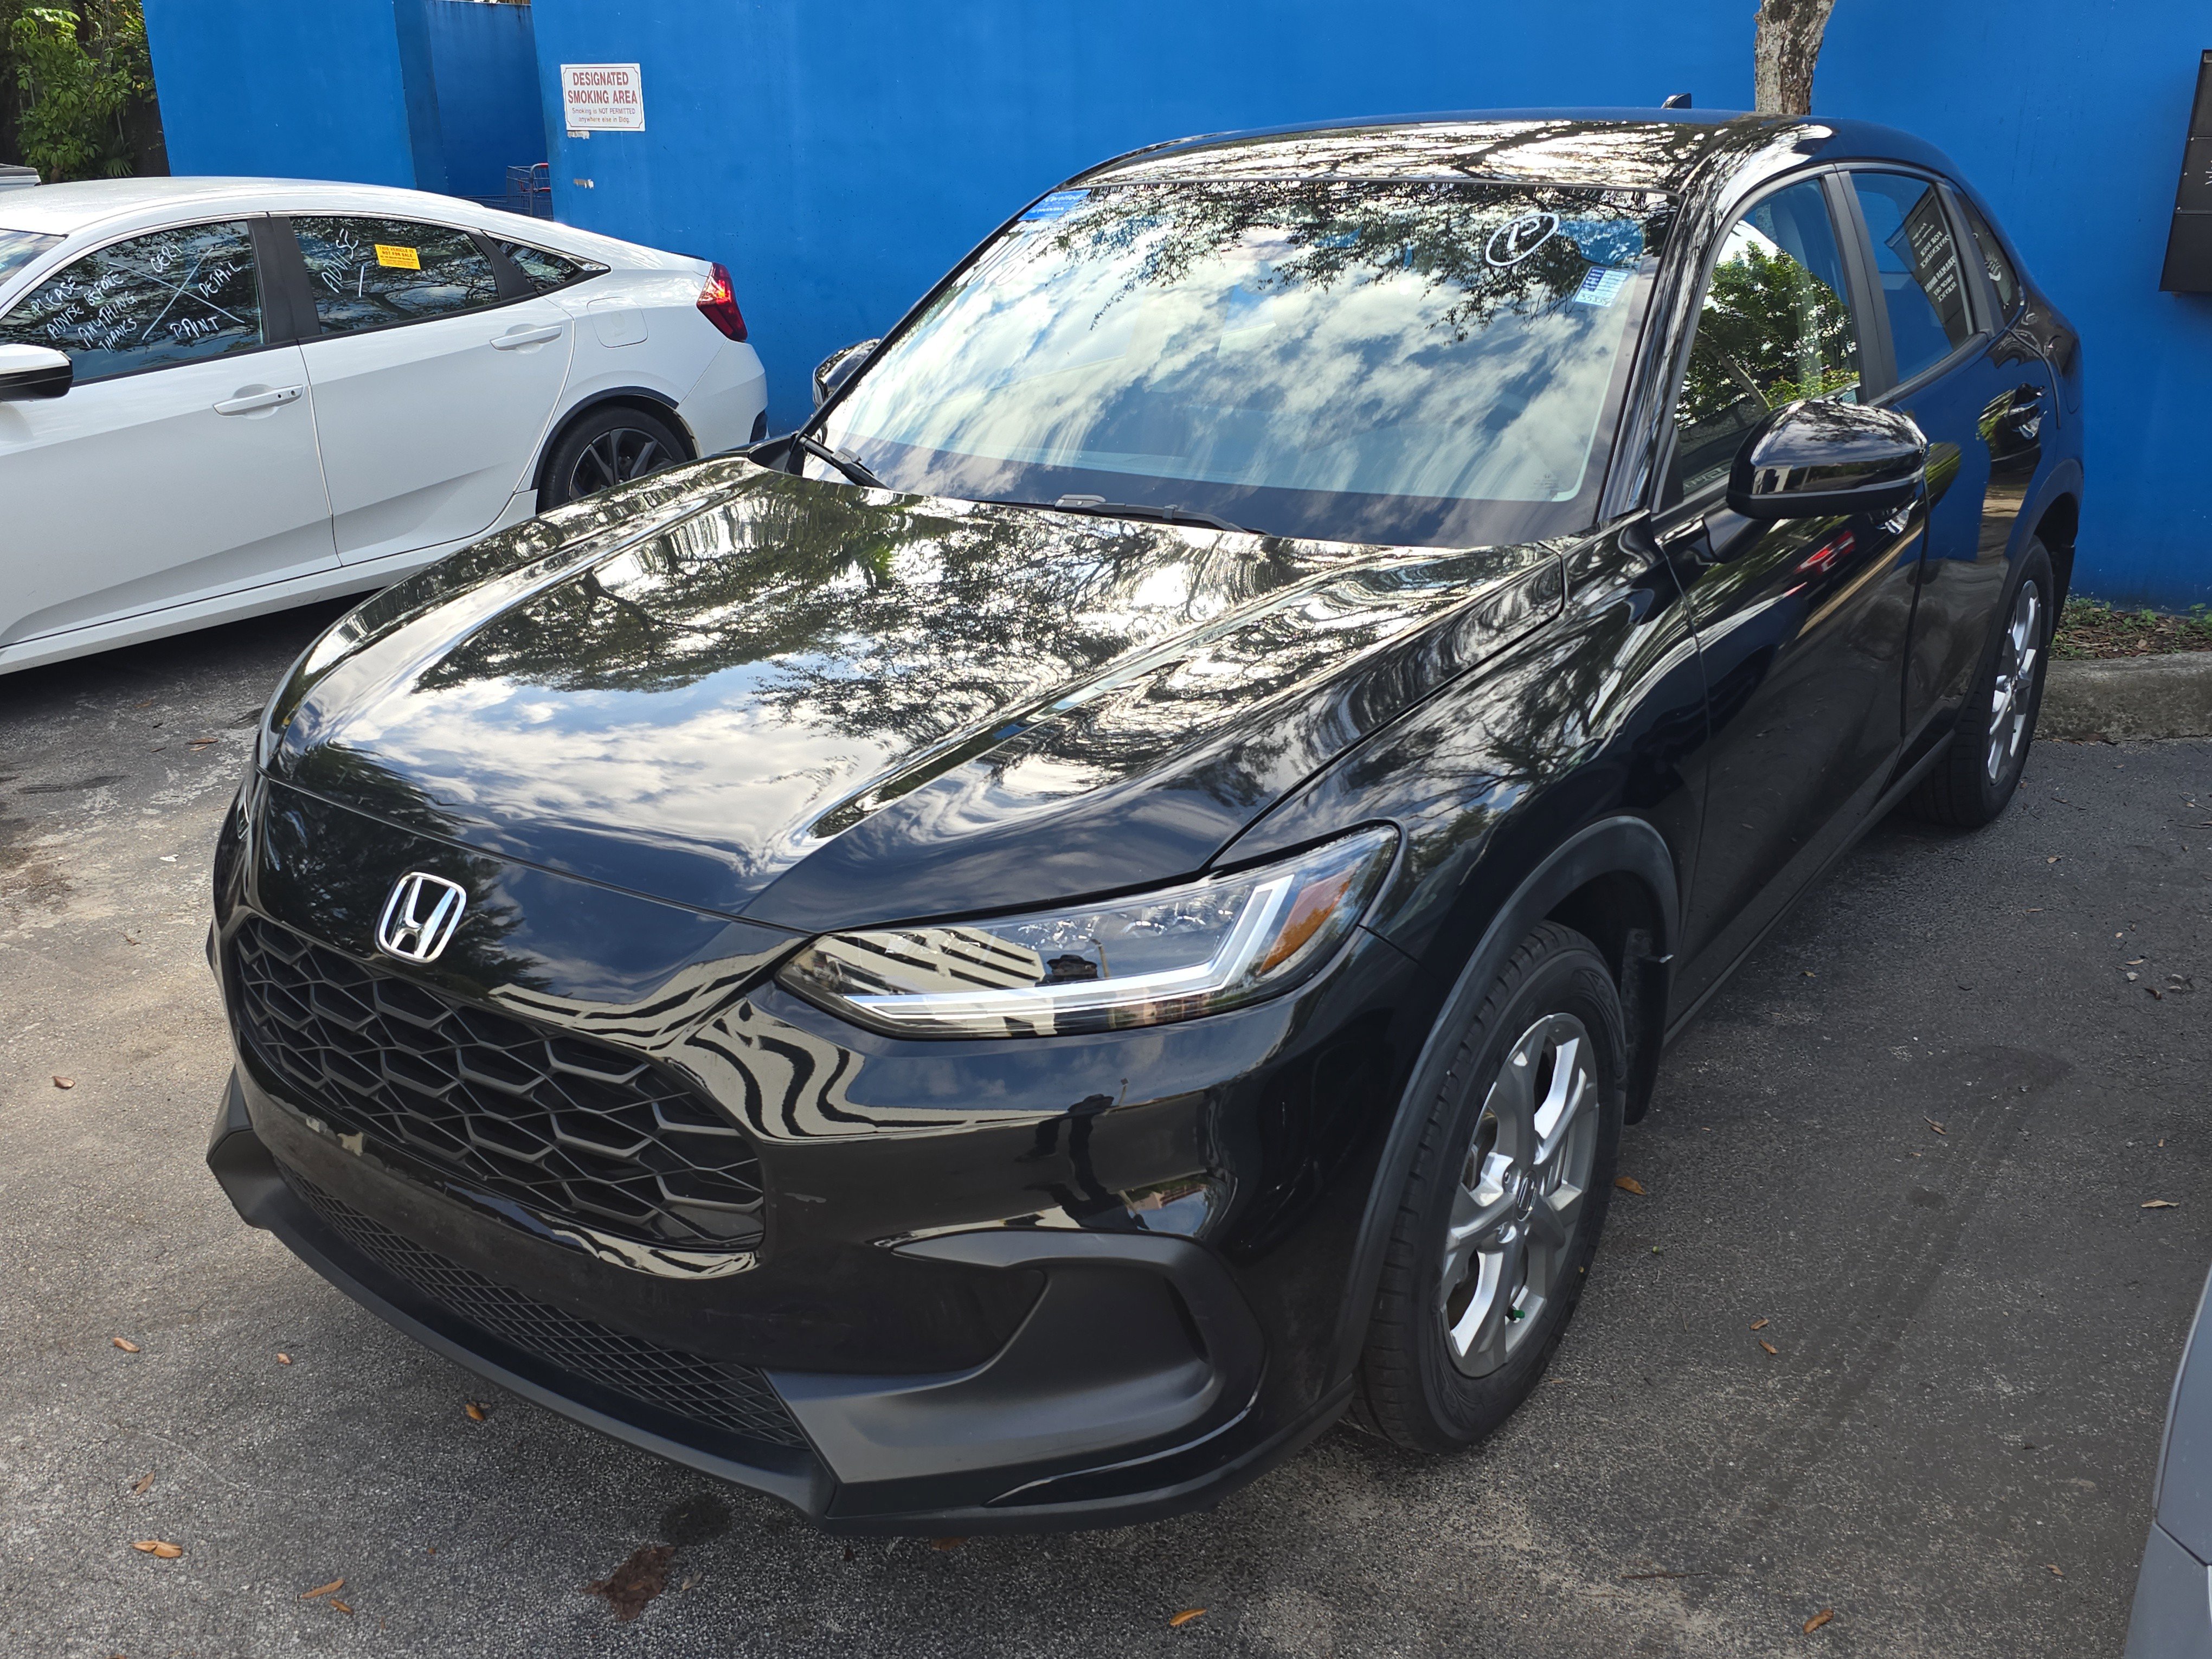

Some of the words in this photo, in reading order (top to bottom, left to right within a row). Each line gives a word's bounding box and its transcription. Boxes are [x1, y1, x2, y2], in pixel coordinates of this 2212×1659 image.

[568, 90, 609, 104] SMOKING
[613, 90, 638, 104] AREA
[573, 72, 629, 86] DESIGNATED
[30, 275, 82, 316] PLEASE
[198, 261, 242, 298] DETAIL
[47, 303, 83, 339] ADVISE
[83, 270, 124, 306] BEFORE
[78, 291, 138, 349] ANYTHING
[99, 318, 137, 354] THANKS
[170, 316, 220, 338] PAINT
